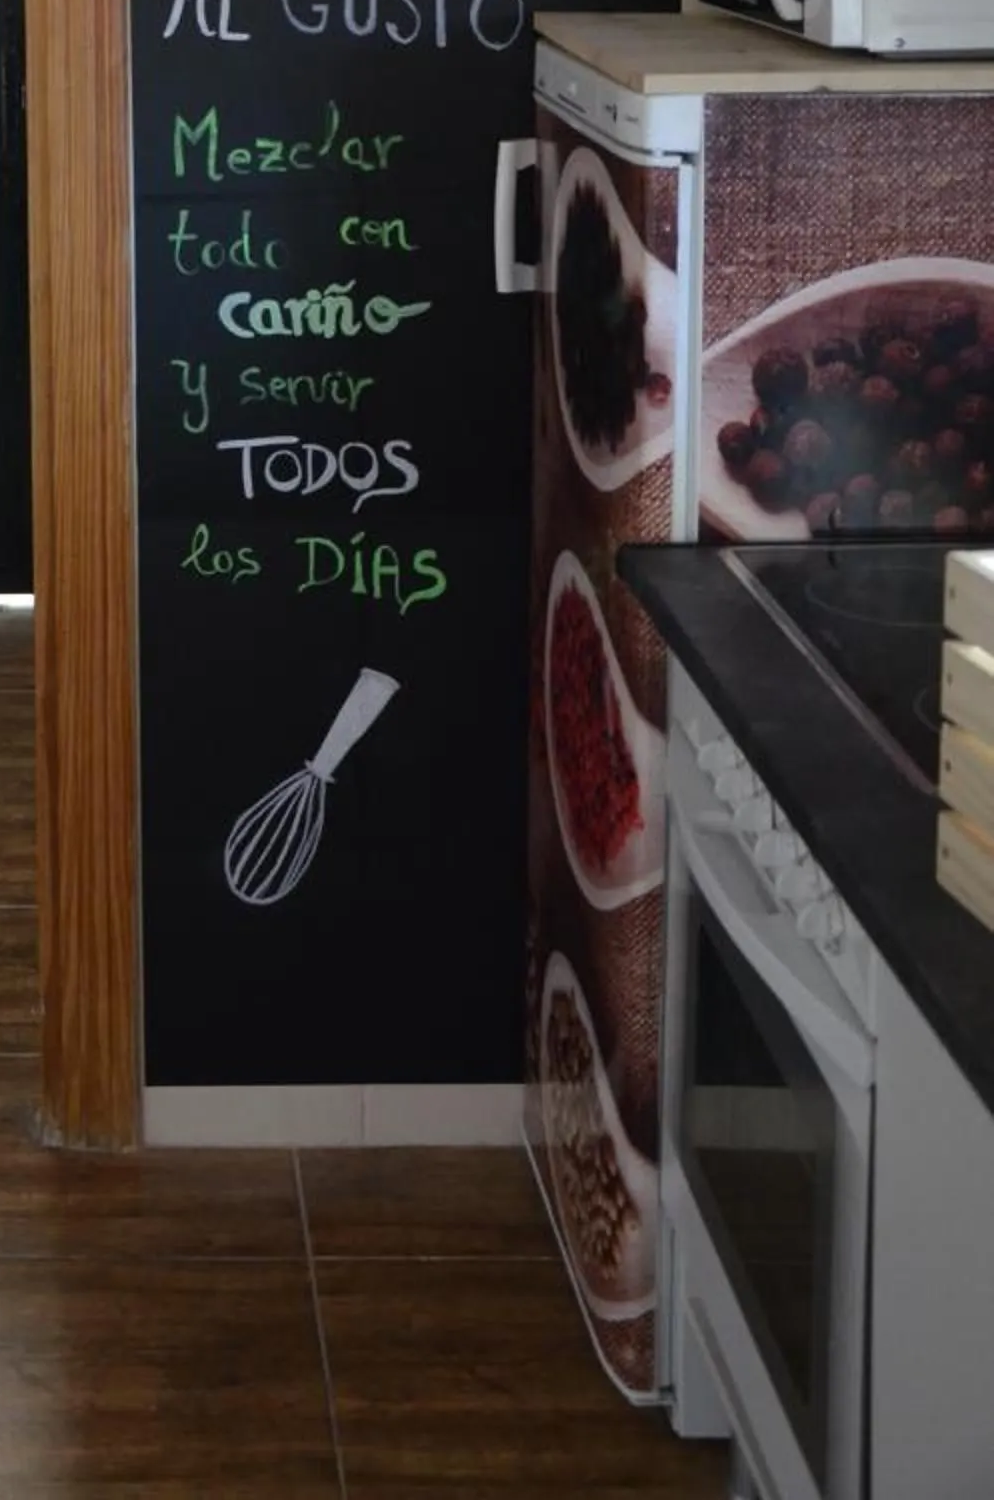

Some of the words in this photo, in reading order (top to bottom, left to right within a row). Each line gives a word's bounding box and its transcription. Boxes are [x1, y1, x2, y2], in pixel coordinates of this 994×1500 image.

[172, 99, 405, 183] Mezclar
[167, 208, 289, 276] todo
[338, 214, 420, 252] con
[215, 434, 421, 515] TODOS
[179, 522, 263, 583] los
